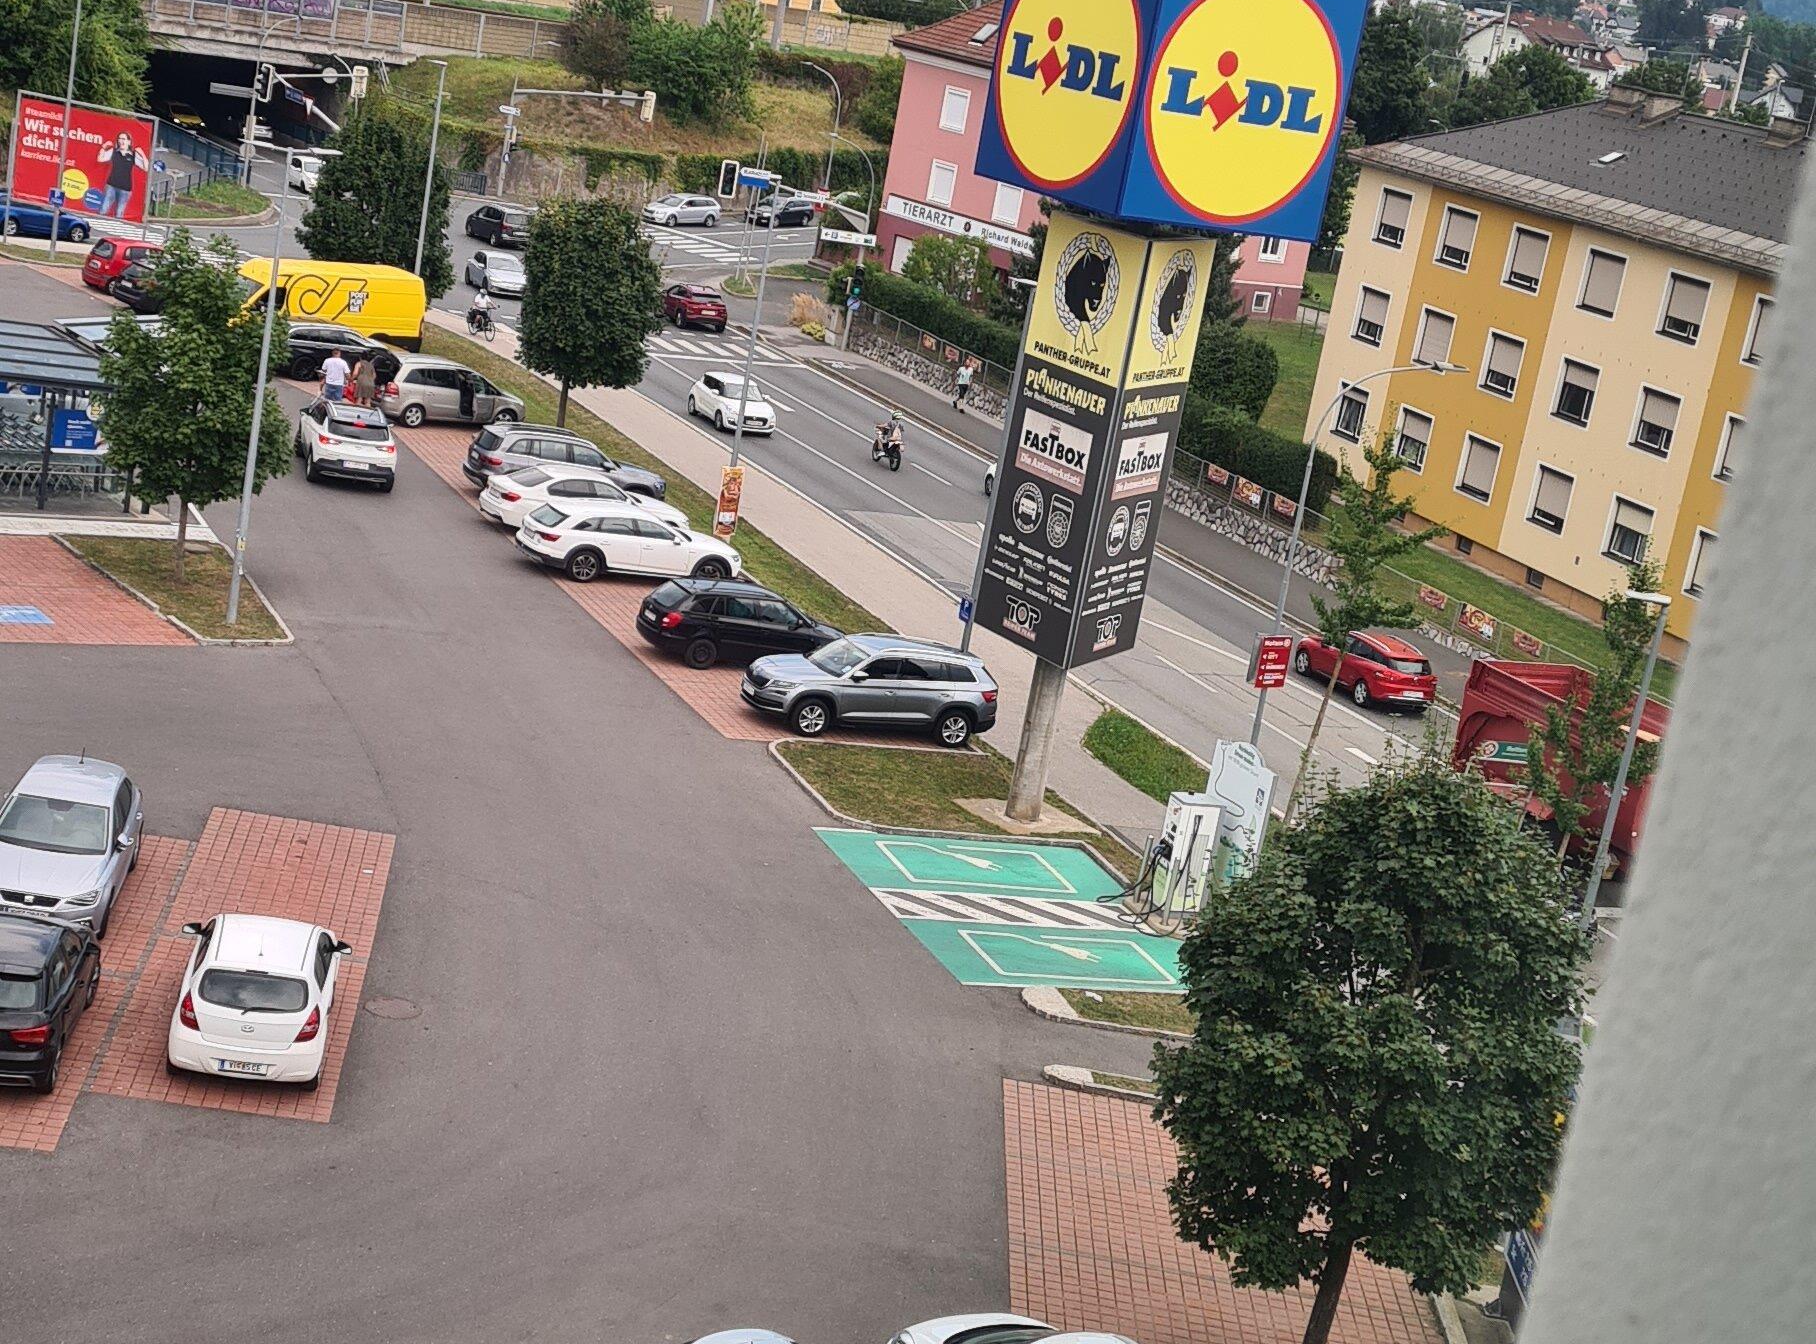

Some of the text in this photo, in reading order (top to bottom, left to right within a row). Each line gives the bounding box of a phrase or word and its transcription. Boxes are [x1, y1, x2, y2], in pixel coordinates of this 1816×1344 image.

[22, 134, 59, 151] dich!
[24, 118, 51, 134] Wir
[902, 202, 954, 228] TIERARZT
[980, 227, 1009, 244] Richard
[1033, 340, 1111, 379] PANTHER-GRUPPE.AT
[1024, 429, 1086, 470] FASTBOX
[1119, 450, 1162, 476] FASTBOX
[1006, 594, 1041, 631] TOP
